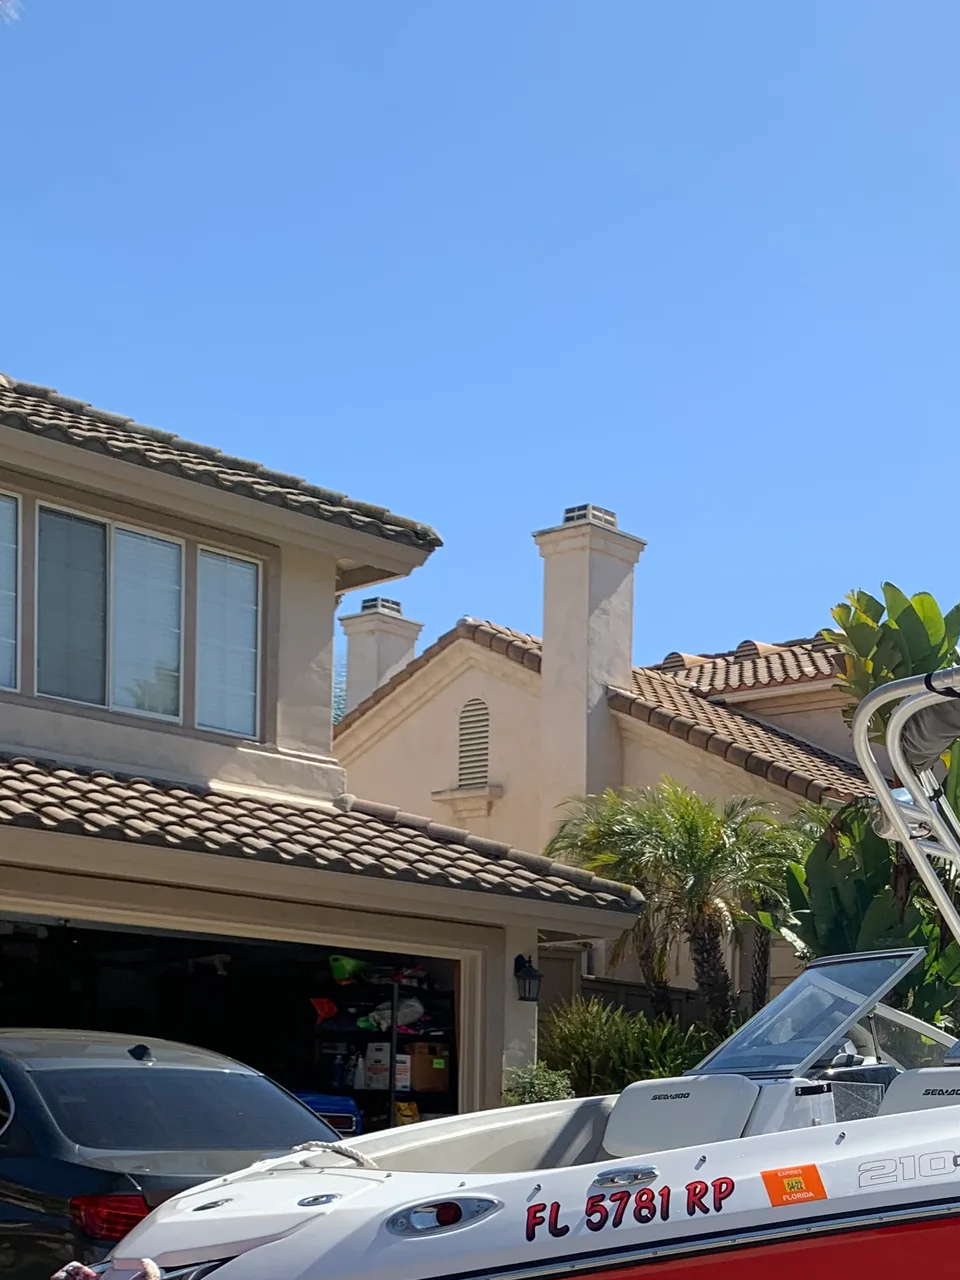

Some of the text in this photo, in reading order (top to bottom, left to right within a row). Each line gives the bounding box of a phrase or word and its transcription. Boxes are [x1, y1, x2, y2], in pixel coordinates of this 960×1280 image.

[858, 1150, 956, 1188] 210
[525, 1177, 735, 1242] FL 5781 RP
[782, 1191, 815, 1201] FLORIDA
